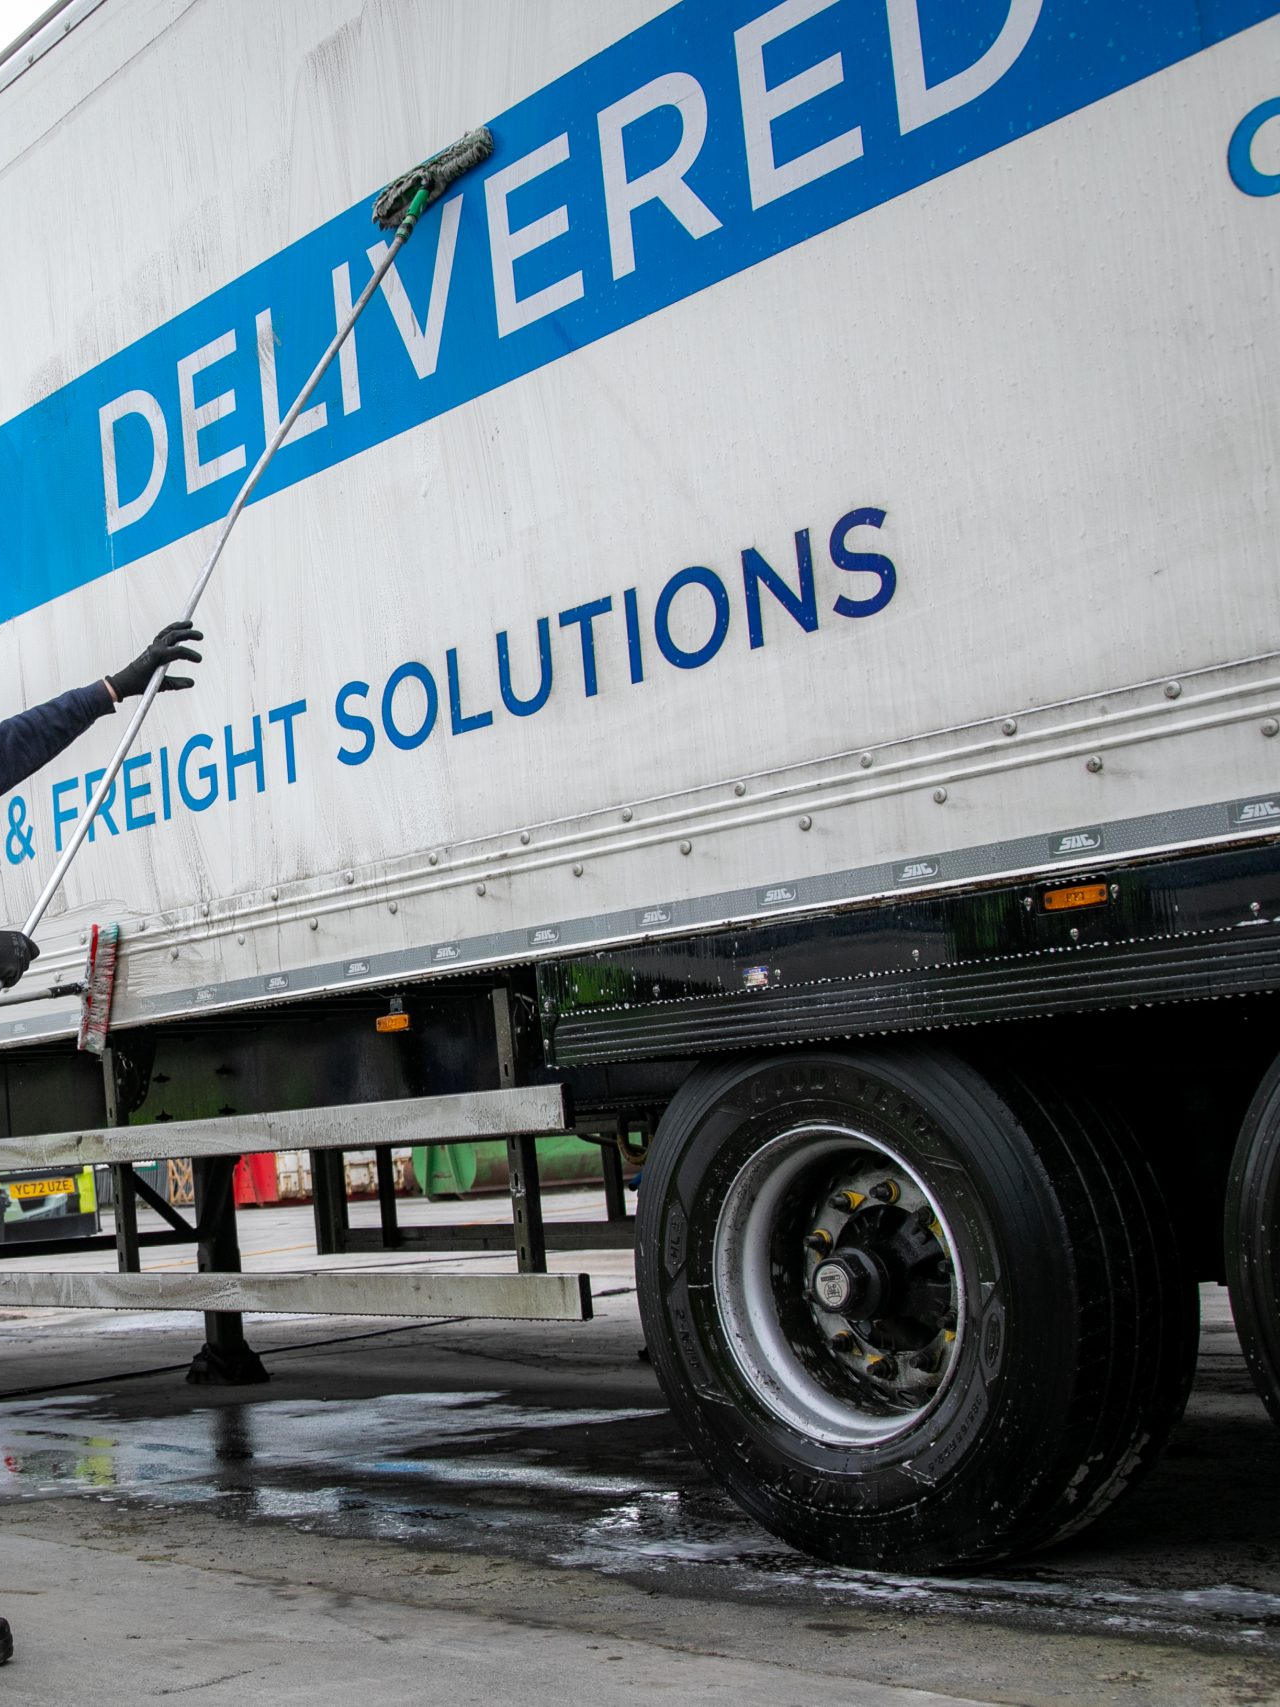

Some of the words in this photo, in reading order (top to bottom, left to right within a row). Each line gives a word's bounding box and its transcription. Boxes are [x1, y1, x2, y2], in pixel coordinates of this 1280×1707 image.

[99, 0, 1045, 536] DELIVERED
[5, 795, 36, 865] &
[53, 699, 308, 852] FREIGHT
[334, 506, 898, 767] SOLUTIONS
[1057, 833, 1096, 851] SDC
[901, 862, 934, 879] SDC
[763, 888, 792, 903] SDC
[642, 910, 667, 924] SDC
[15, 1182, 45, 1196] YC72
[47, 1179, 71, 1193] UZE
